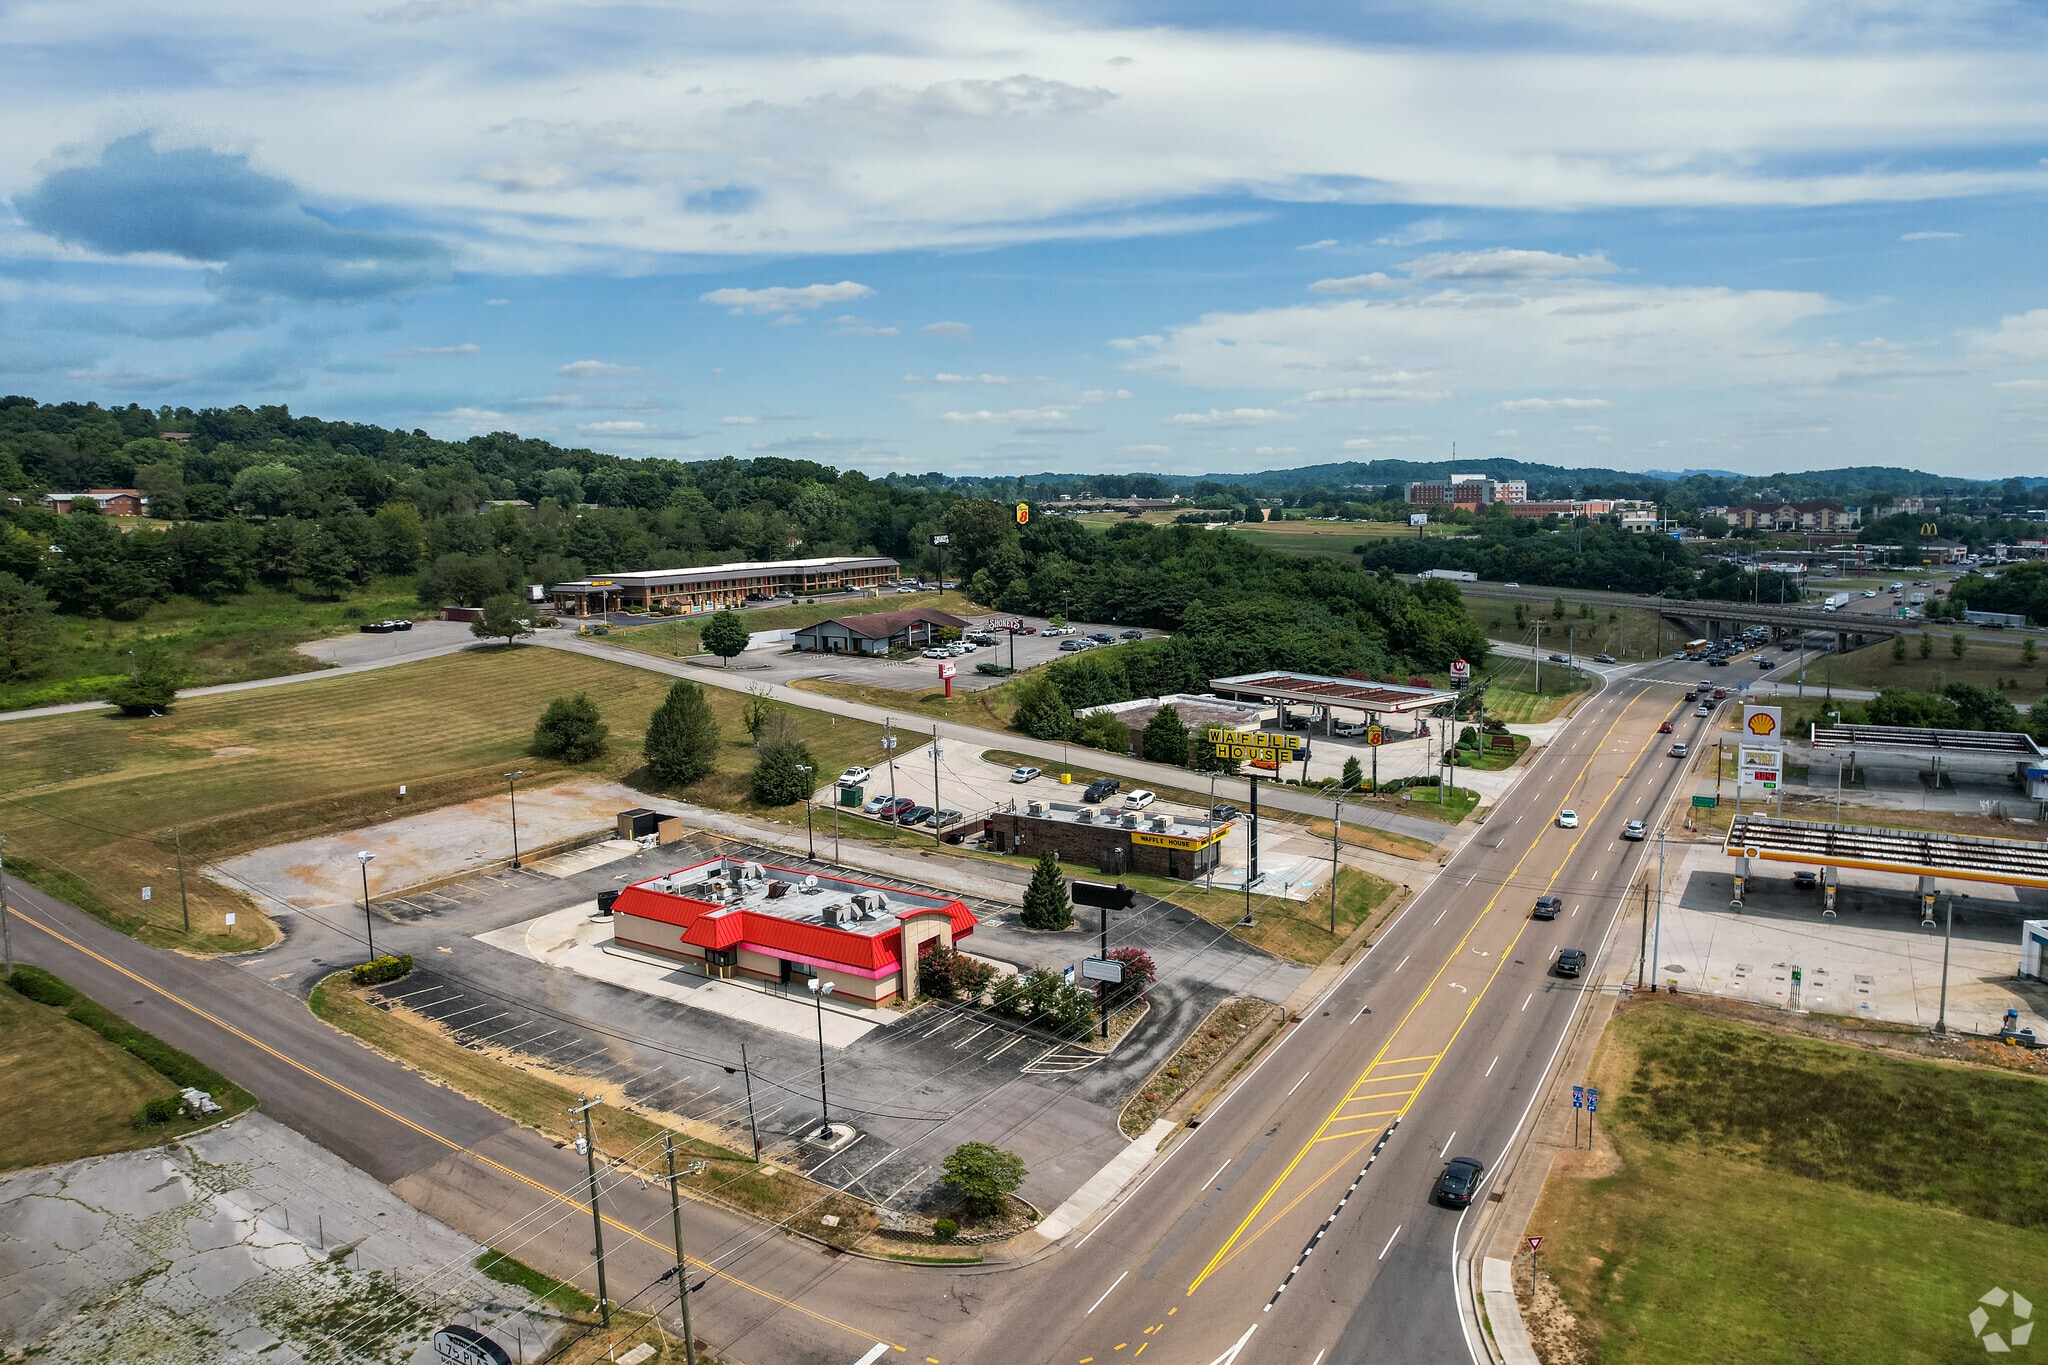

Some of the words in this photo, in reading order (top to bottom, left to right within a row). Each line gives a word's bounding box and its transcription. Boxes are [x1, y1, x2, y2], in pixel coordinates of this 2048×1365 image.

[1019, 511, 1028, 523] 8
[1210, 730, 1297, 749] WAFFLE
[1370, 733, 1381, 745] 8
[1218, 746, 1290, 762] HOUSE
[1140, 835, 1164, 844] WAFFLE
[1168, 840, 1190, 848] HOUSE
[445, 1343, 460, 1359] 75
[463, 1351, 489, 1365] PLA
